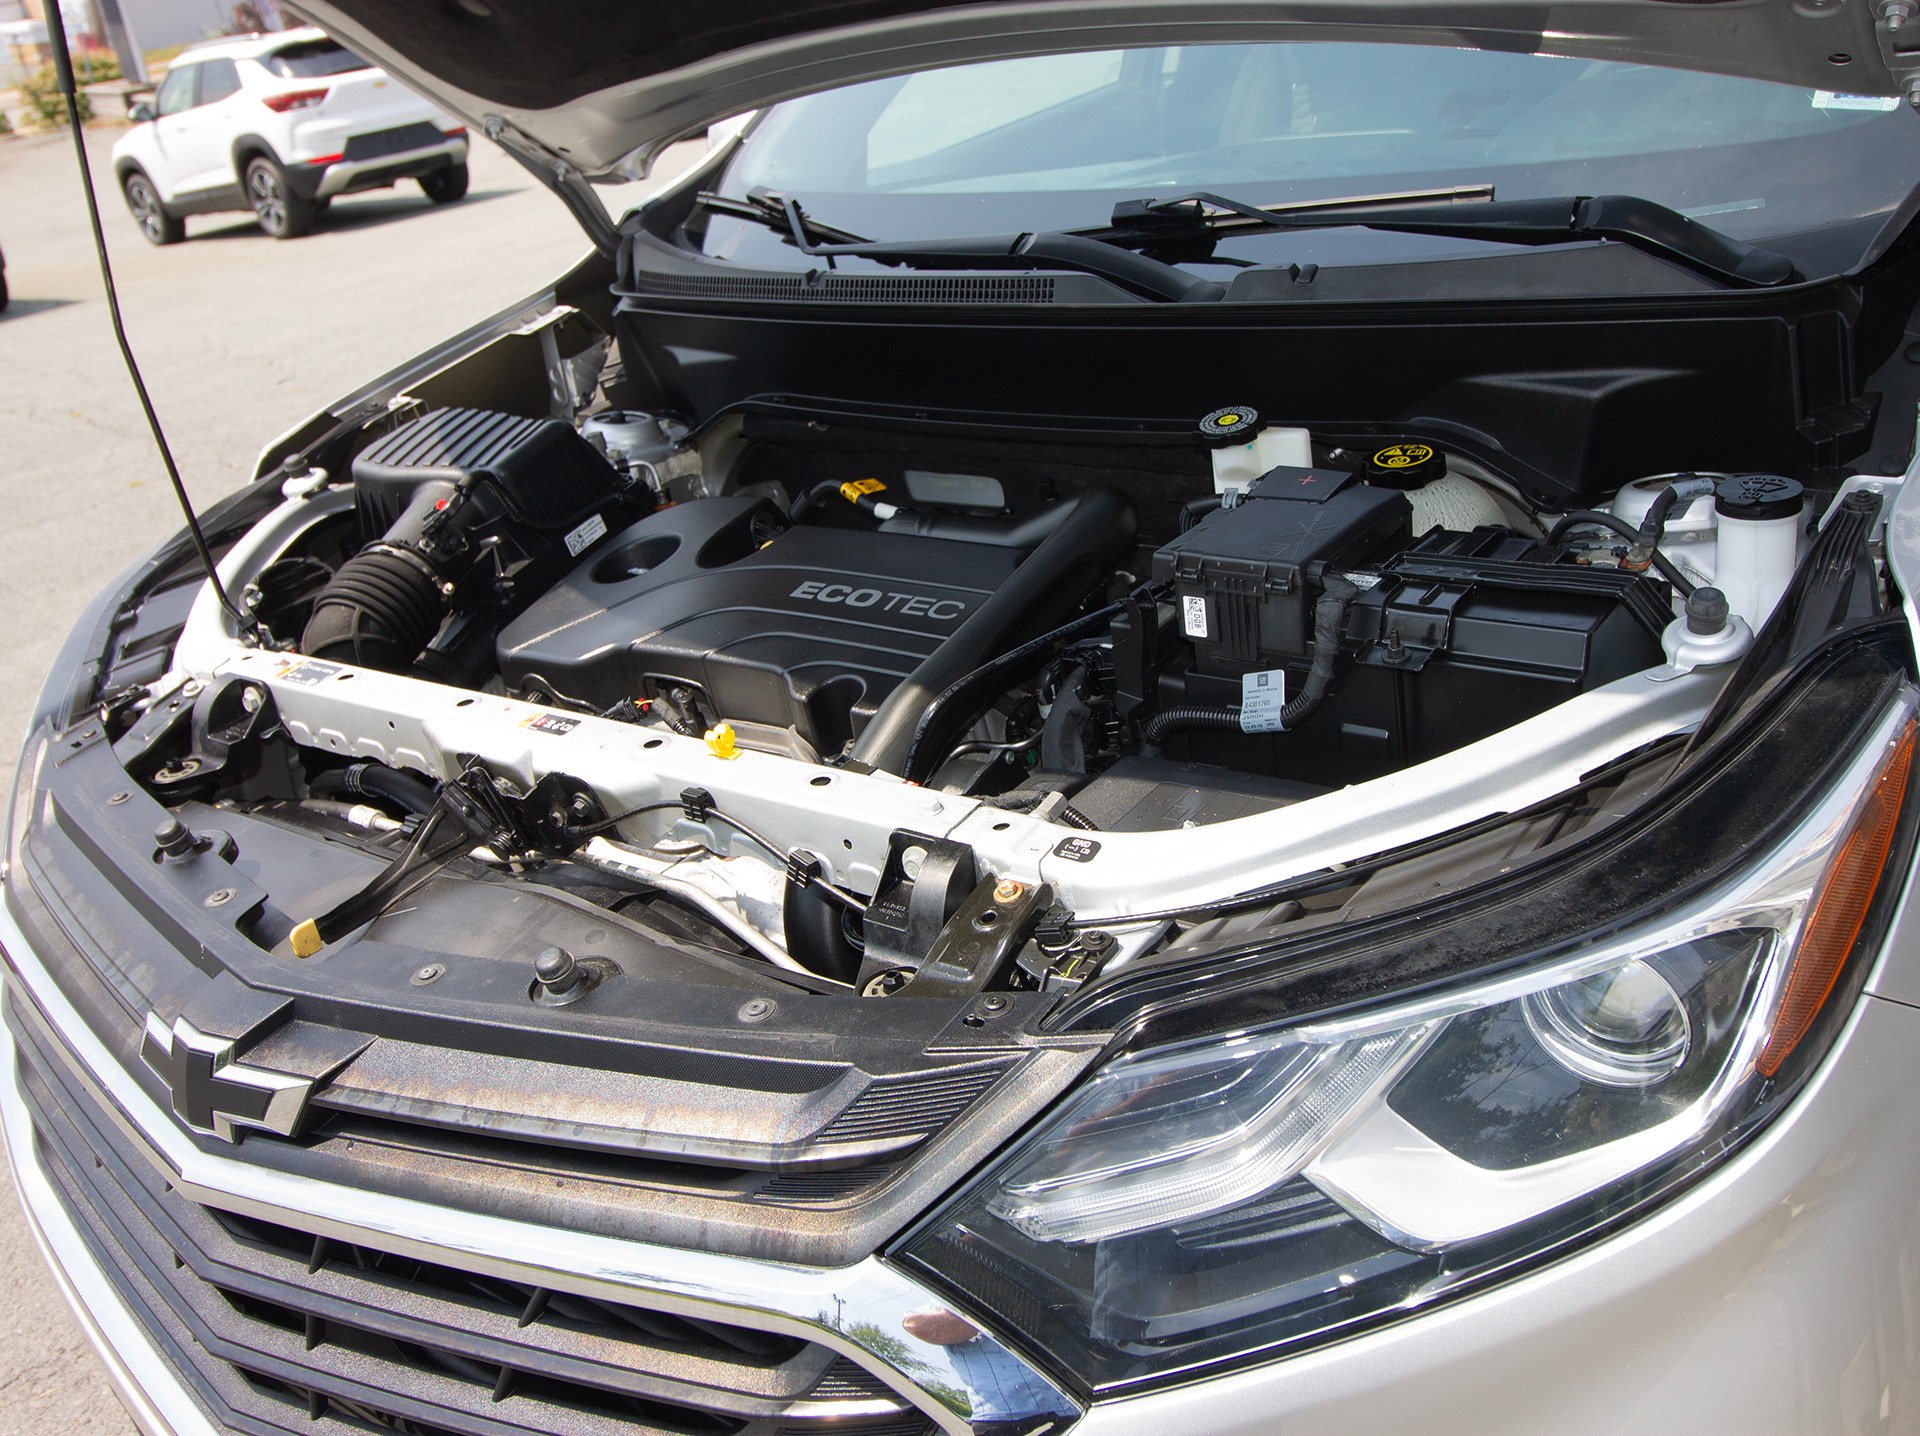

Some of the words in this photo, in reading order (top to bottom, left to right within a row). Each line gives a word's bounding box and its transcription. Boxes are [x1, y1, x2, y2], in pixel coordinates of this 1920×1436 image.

[789, 581, 966, 620] ECOTEC
[1244, 700, 1271, 709] 84301795
[1071, 839, 1092, 848] GND
